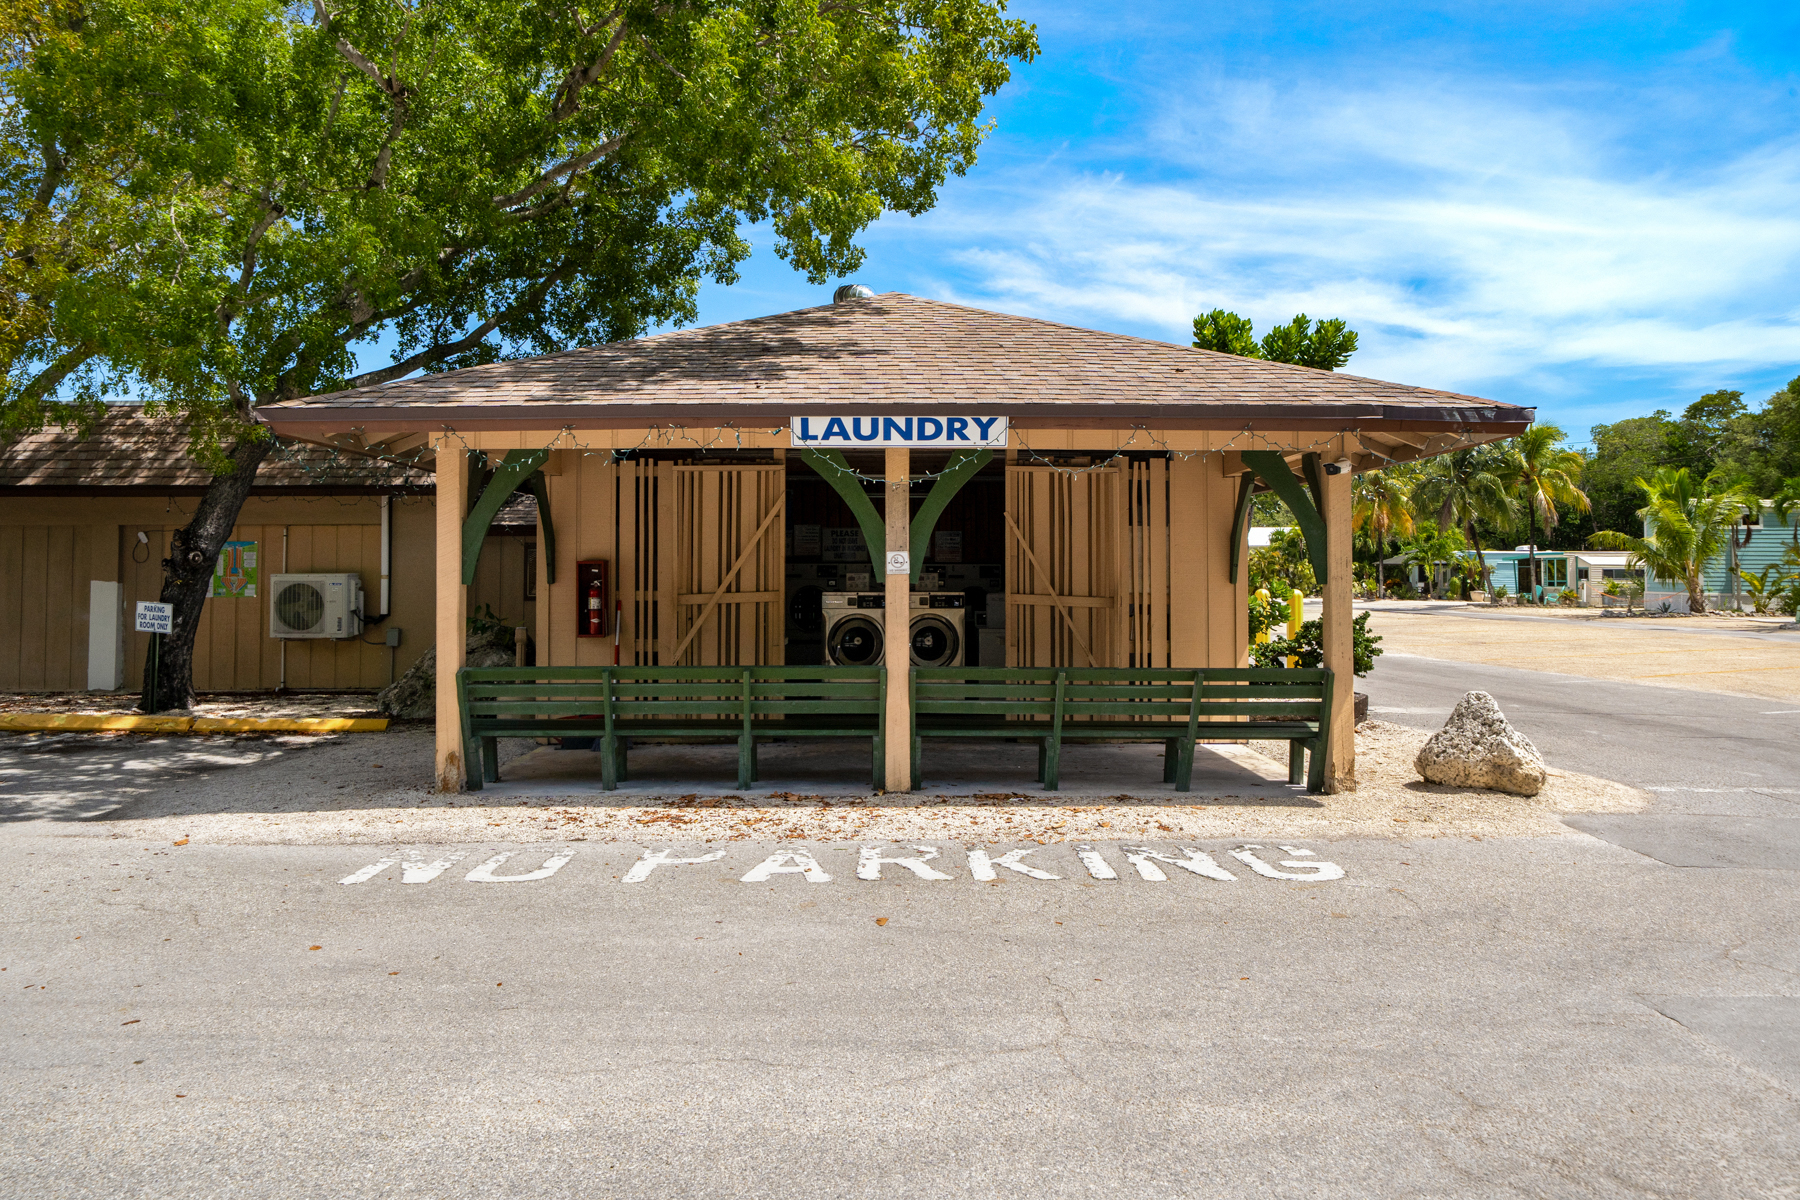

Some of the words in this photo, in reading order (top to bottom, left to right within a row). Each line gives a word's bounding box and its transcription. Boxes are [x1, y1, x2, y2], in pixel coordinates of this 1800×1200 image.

[800, 417, 999, 441] LAUNDRY
[144, 605, 165, 614] PARKING
[138, 613, 147, 621] FOR
[149, 614, 170, 623] LAUNDRY
[140, 621, 155, 629] ROOM
[157, 623, 168, 631] ONLY
